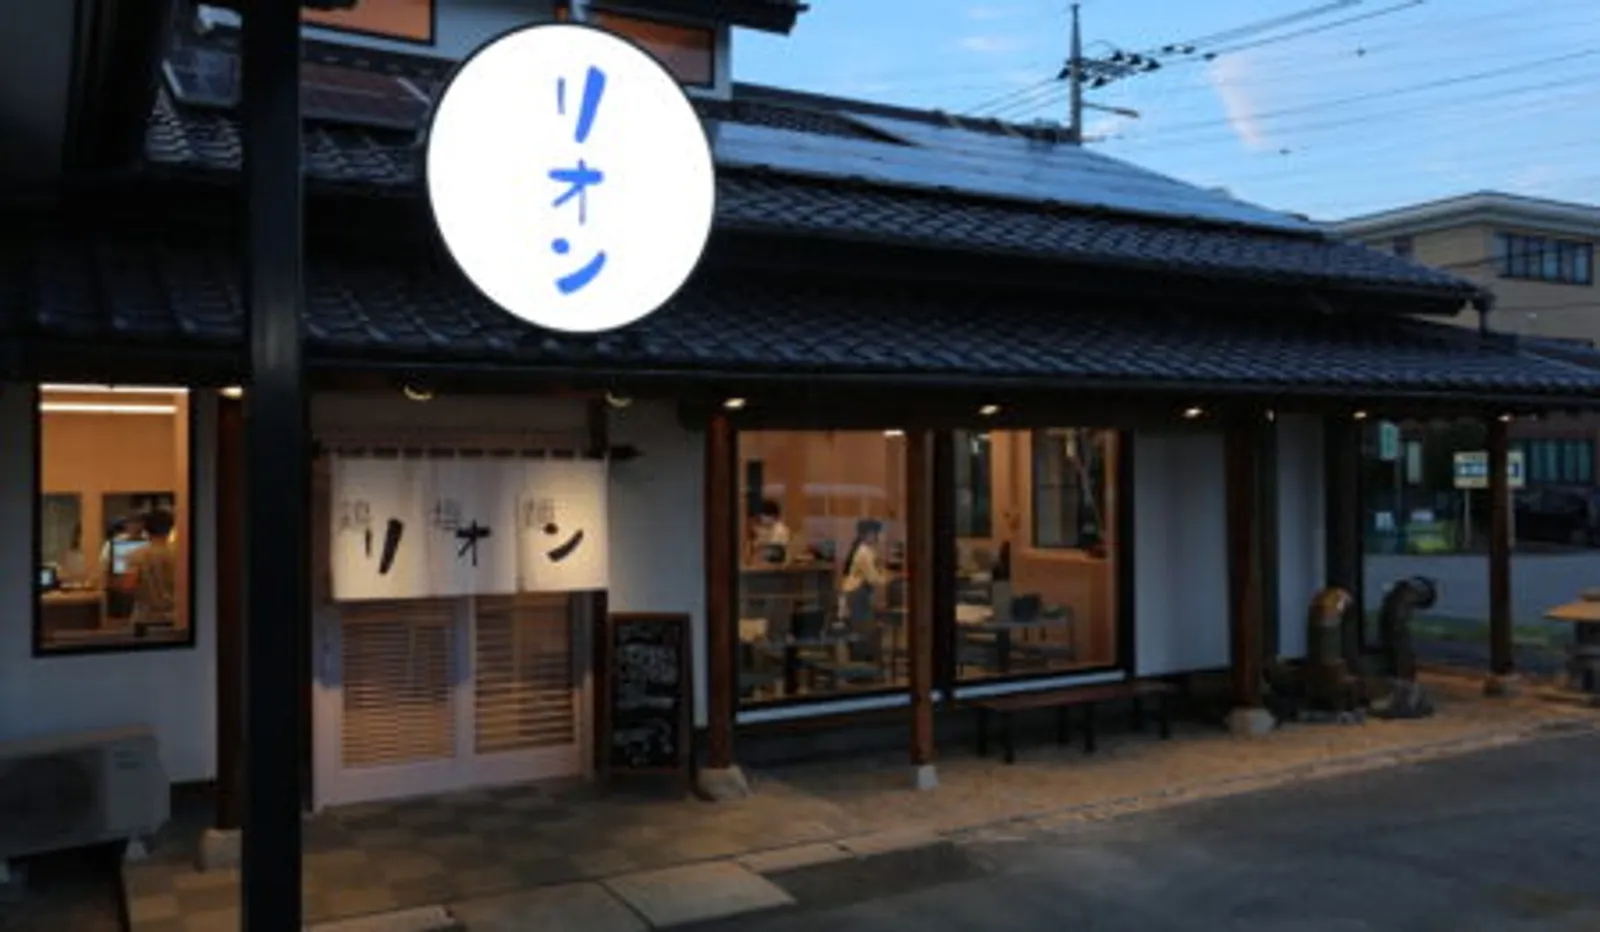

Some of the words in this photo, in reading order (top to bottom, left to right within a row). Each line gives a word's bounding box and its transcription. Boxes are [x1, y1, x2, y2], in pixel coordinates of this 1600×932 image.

[547, 65, 608, 296] リオン
[363, 518, 585, 575] リオン
